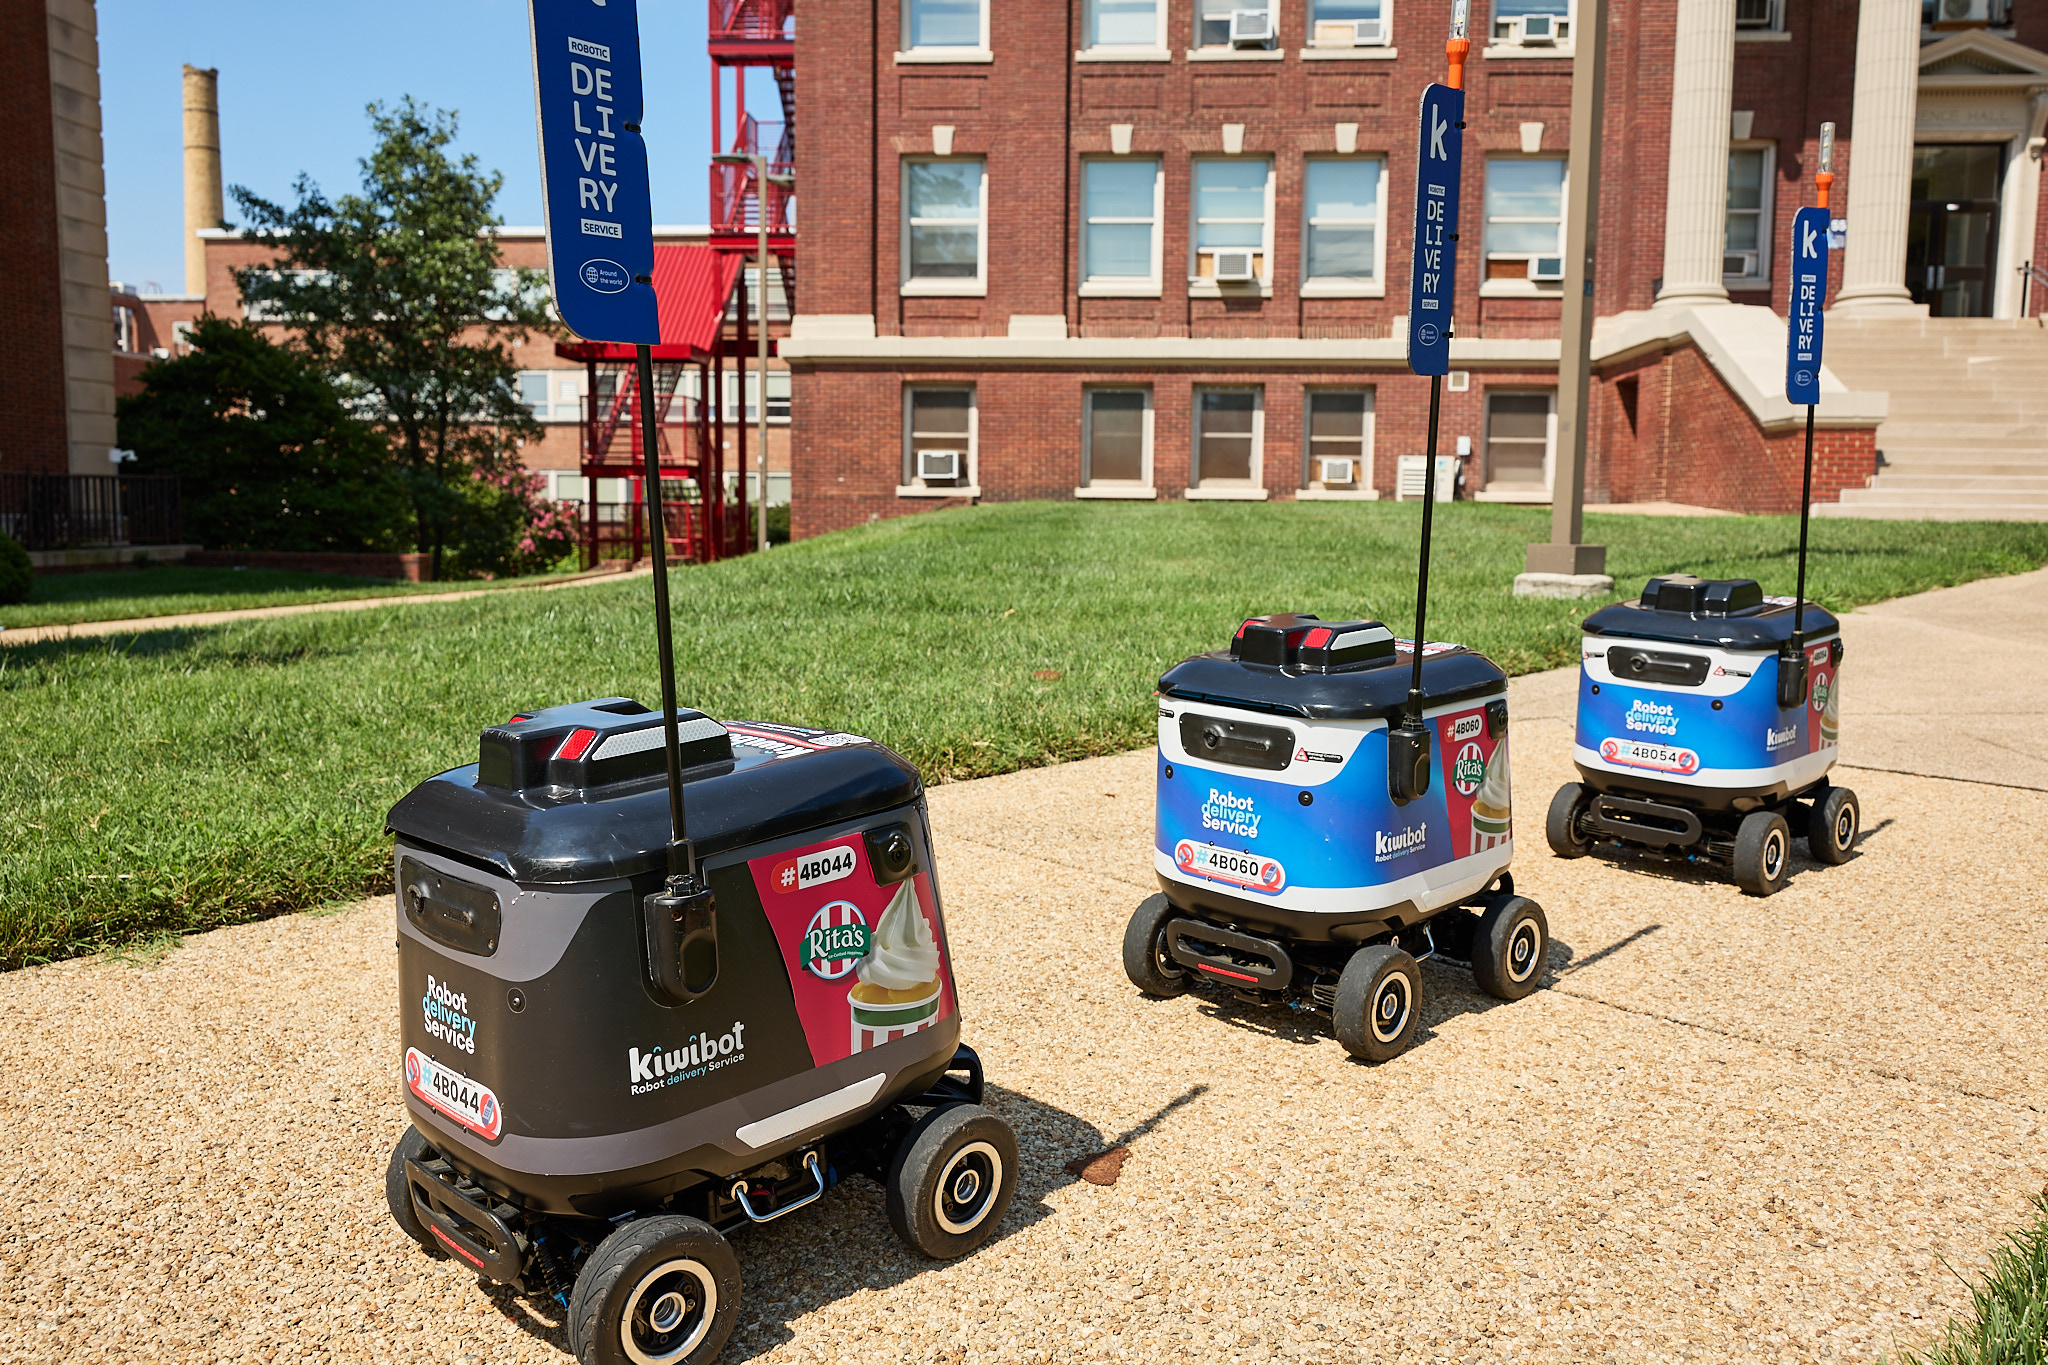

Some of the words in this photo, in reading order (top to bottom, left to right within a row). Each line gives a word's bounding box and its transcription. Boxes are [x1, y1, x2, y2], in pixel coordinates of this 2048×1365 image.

[571, 41, 608, 58] ROBOTIC
[584, 222, 619, 236] SERVICE
[1625, 708, 1680, 728] delivery
[1633, 700, 1674, 716] Robot
[1626, 718, 1677, 736] Service
[1456, 759, 1482, 780] Rita's
[1210, 788, 1254, 812] Robot
[1202, 800, 1262, 828] delivery
[1202, 813, 1258, 838] Service
[1375, 854, 1392, 862] Robot
[810, 924, 864, 960] Rita's
[428, 974, 468, 1014] Robot
[422, 991, 476, 1040] delivery
[424, 1010, 476, 1055] Service
[628, 1021, 745, 1084] kiwibot
[630, 1078, 665, 1096] Robot
[666, 1066, 707, 1086] delivery
[708, 1052, 745, 1072] Service
